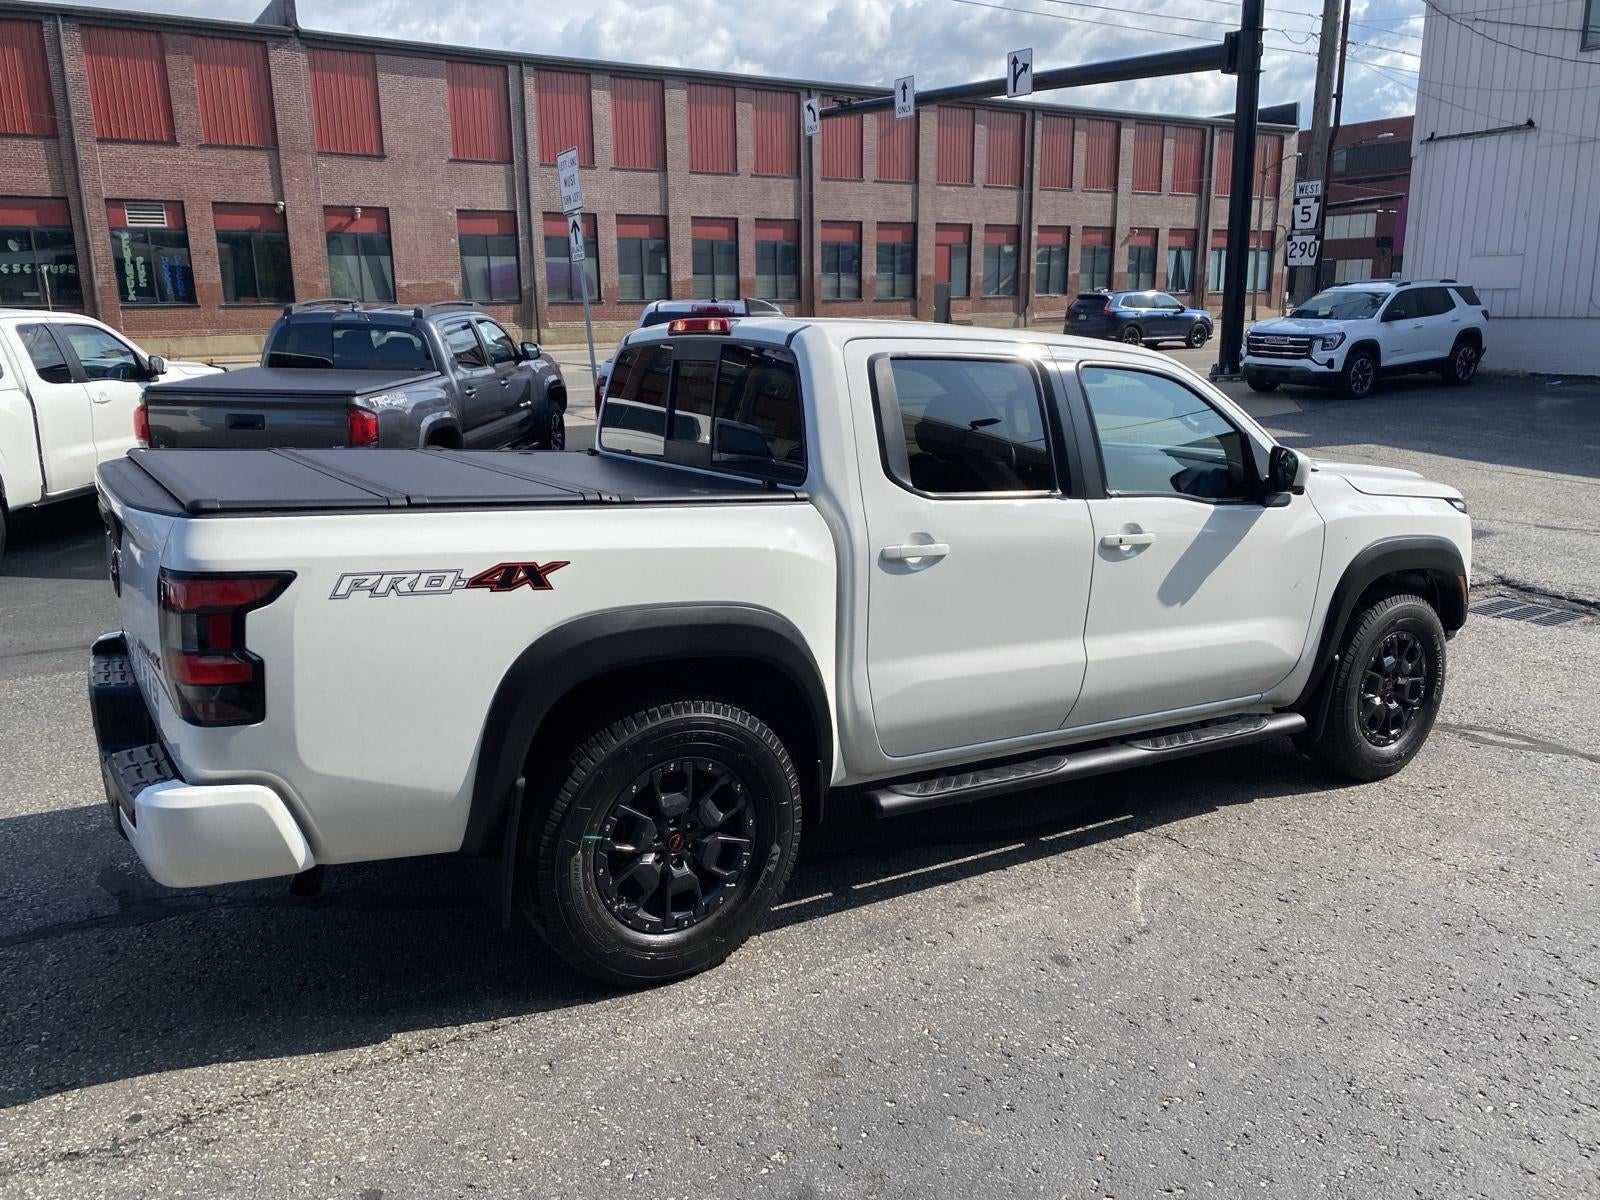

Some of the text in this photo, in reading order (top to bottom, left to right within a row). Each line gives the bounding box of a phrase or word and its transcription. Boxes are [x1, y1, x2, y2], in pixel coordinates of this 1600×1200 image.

[898, 105, 911, 115] ONLY
[807, 125, 818, 133] ONLY
[563, 173, 576, 187] MUST
[1299, 184, 1319, 194] WEST
[1300, 205, 1312, 223] 5
[1288, 241, 1317, 258] 290
